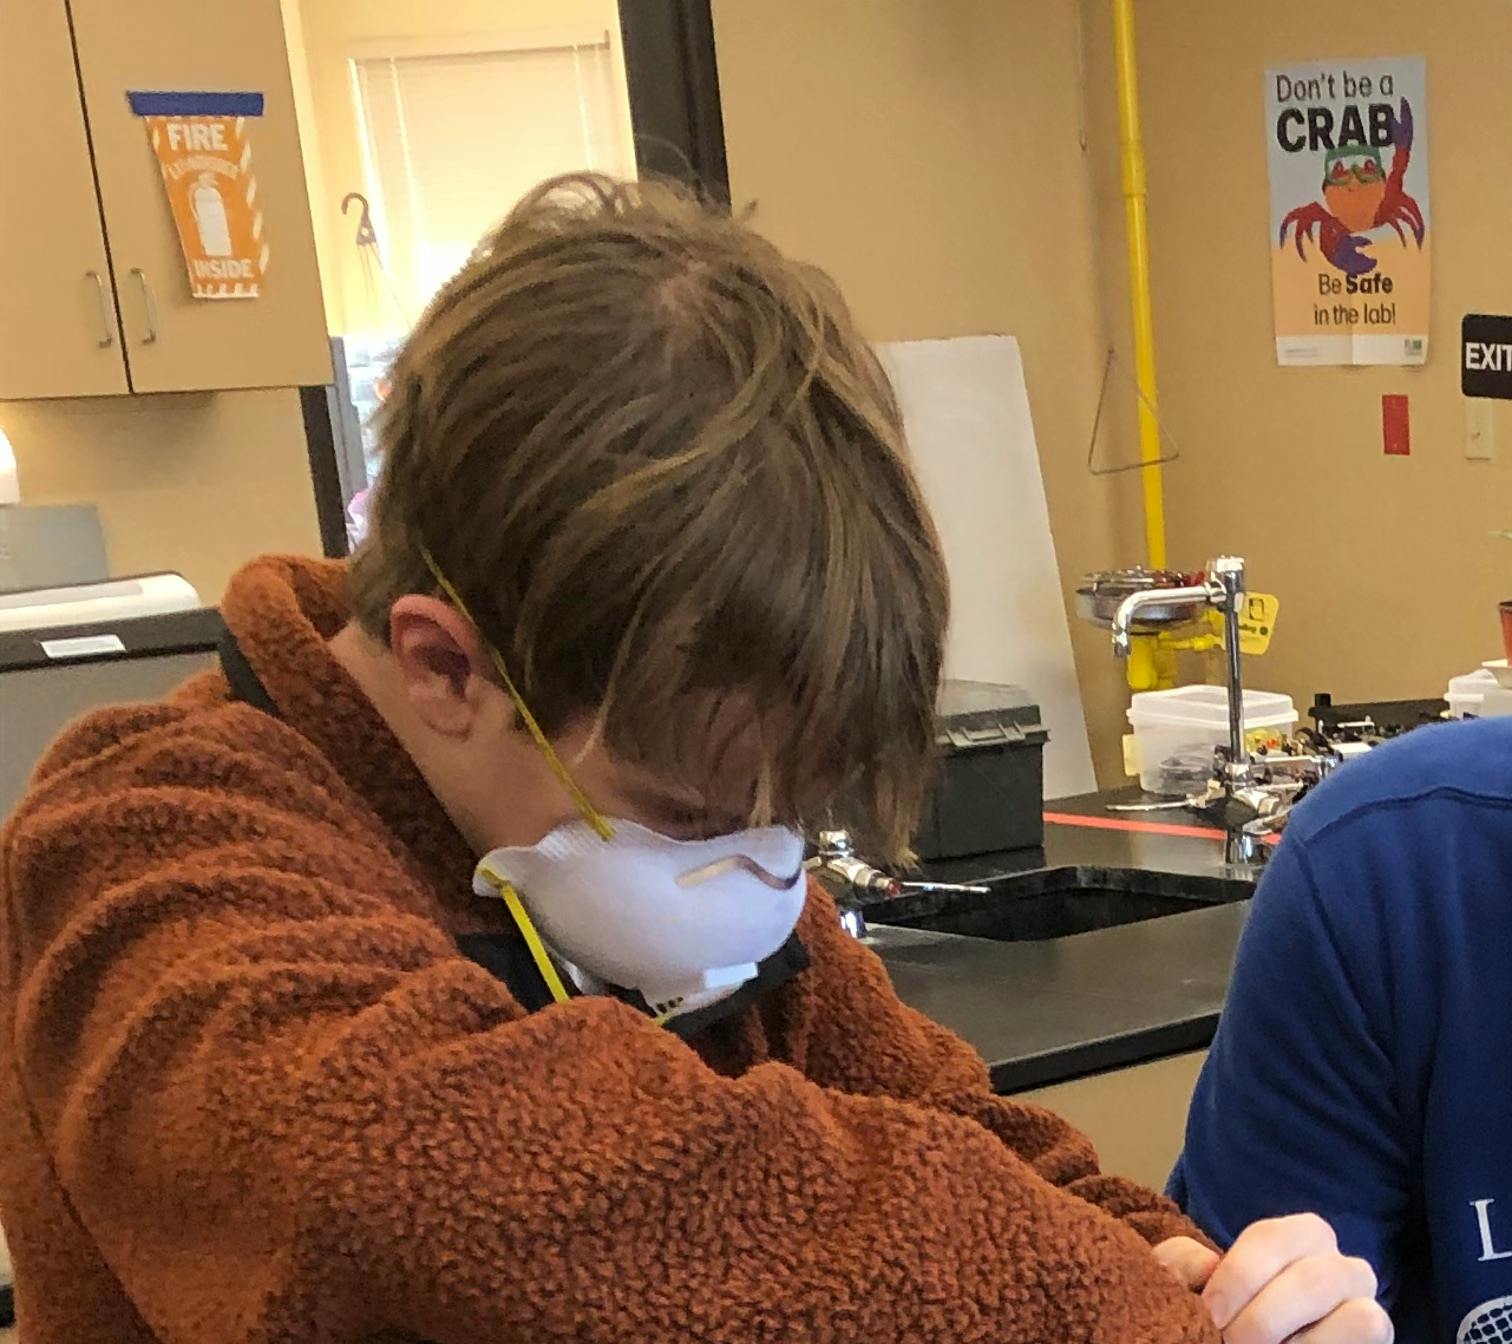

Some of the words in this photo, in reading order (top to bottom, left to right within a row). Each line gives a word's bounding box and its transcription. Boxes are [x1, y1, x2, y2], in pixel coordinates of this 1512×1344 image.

[1276, 71, 1336, 104] Don't
[1343, 70, 1374, 99] be
[1379, 74, 1394, 97] a
[167, 123, 228, 151] FIRE
[1276, 103, 1396, 153] CRAB
[193, 259, 253, 279] INSIDE
[1318, 274, 1343, 296] Be
[1345, 273, 1393, 295] Safe
[1314, 305, 1330, 325] in
[1333, 305, 1361, 325] the
[1364, 303, 1396, 326] lab!
